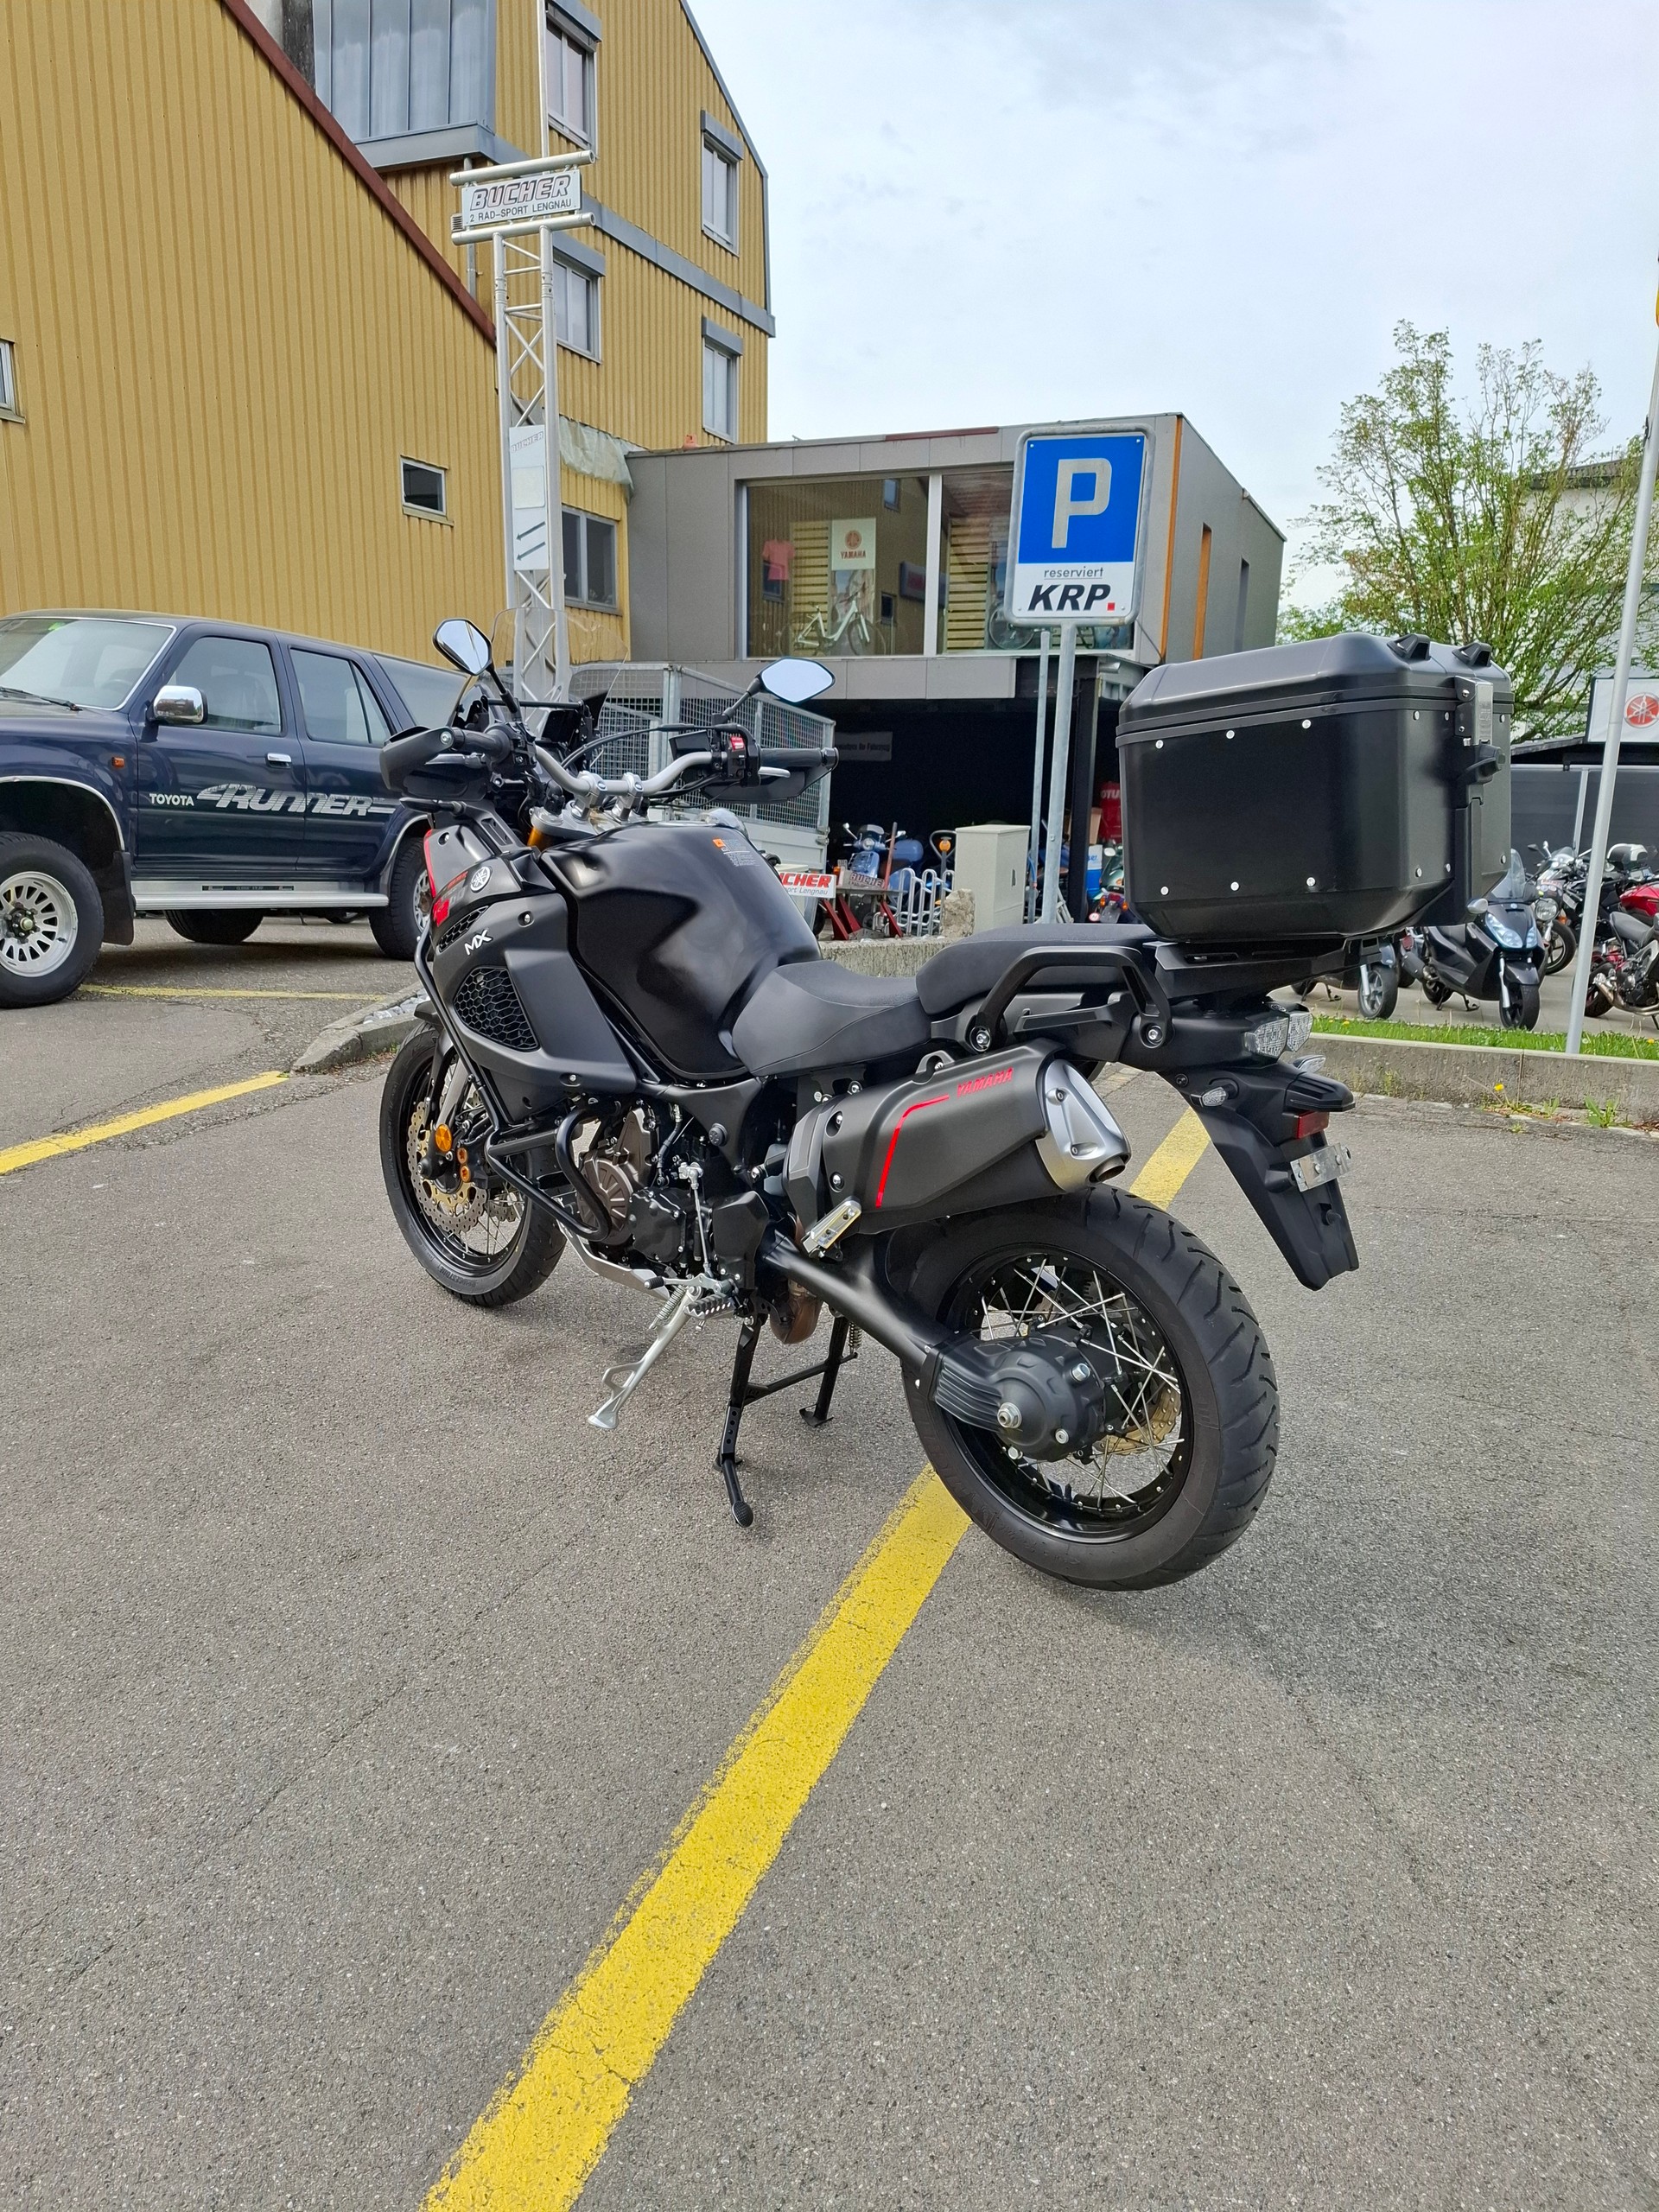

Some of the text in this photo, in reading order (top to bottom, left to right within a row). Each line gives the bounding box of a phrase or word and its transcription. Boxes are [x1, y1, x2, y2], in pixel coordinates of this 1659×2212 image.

[470, 175, 571, 211] BUCHER
[478, 206, 528, 221] RAD-SPORT
[531, 199, 572, 213] LENGNAU
[511, 431, 544, 453] BUCHER
[1052, 458, 1112, 549] P
[840, 550, 867, 560] YAMAHA
[1044, 566, 1103, 578] reserviert
[149, 793, 194, 806] TOYOTA
[779, 873, 832, 888] CHER
[799, 887, 829, 895] Lengnau
[957, 1066, 1014, 1098] YAMAHA
